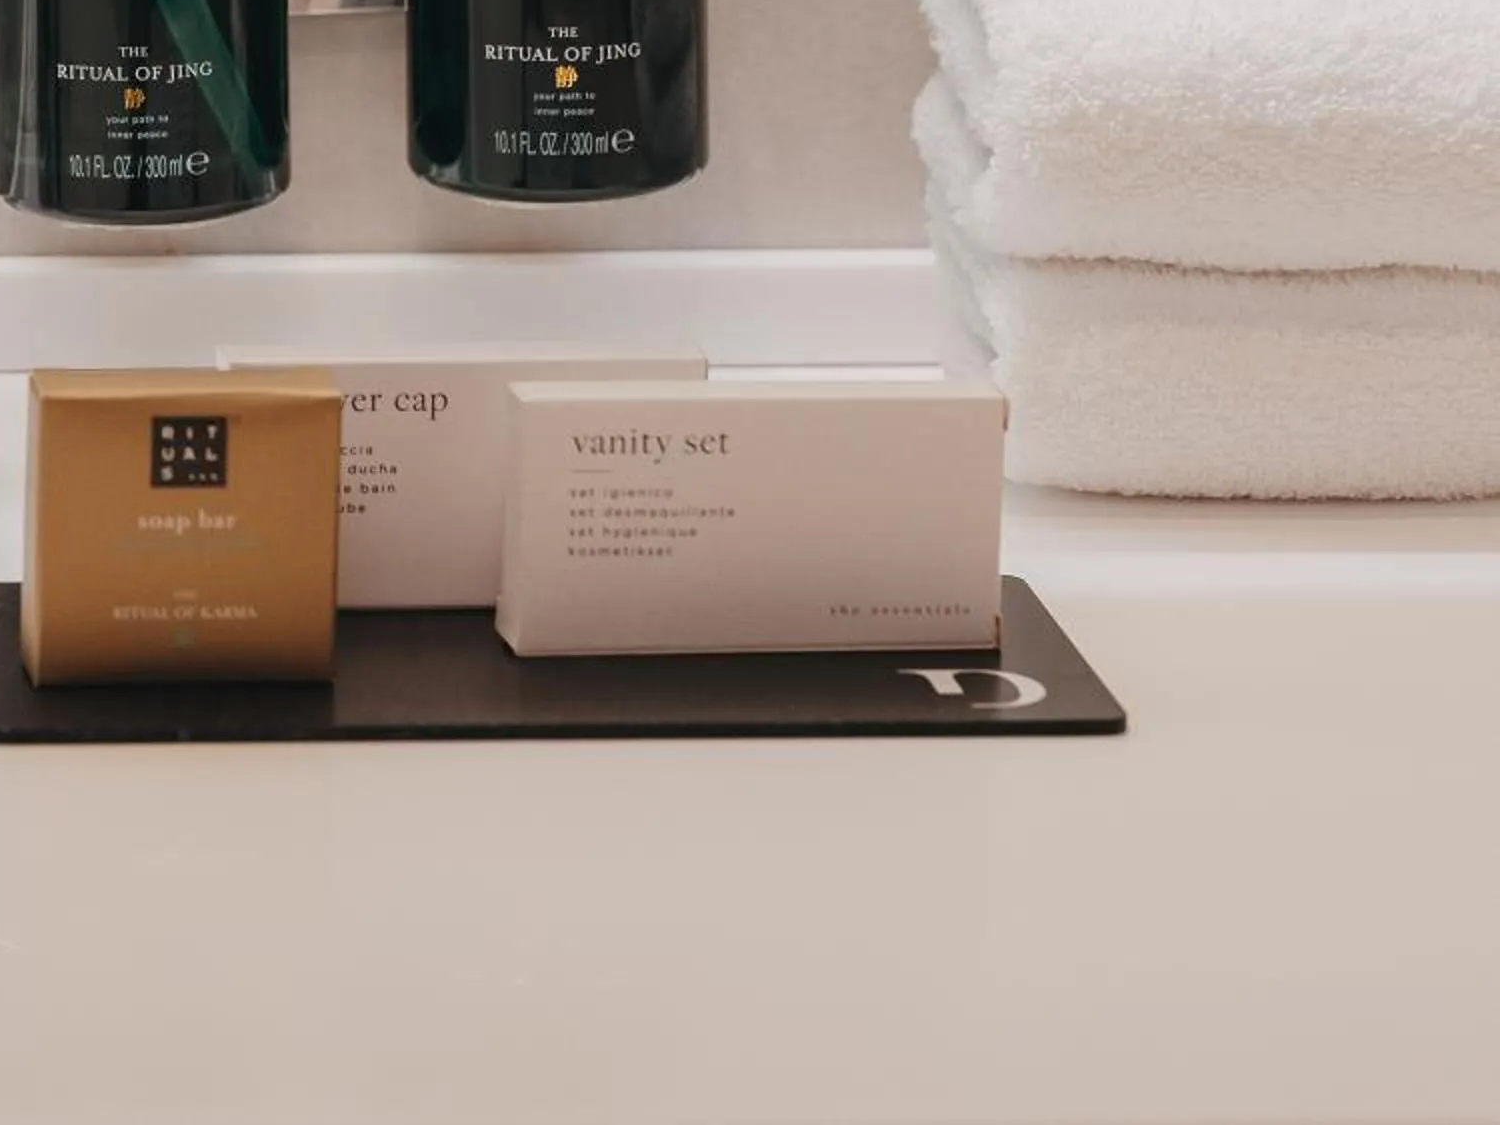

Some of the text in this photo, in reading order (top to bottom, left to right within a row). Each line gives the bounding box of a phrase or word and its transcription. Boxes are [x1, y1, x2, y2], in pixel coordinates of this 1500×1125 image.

[548, 26, 579, 38] THE
[117, 46, 149, 58] THE
[484, 42, 642, 64] RITUAL OF JING
[56, 61, 213, 84] RITUAL OF JING
[571, 131, 593, 156] 300
[595, 131, 609, 154] ml
[145, 155, 167, 179] 300
[169, 154, 183, 177] ml
[394, 392, 449, 421] cap
[572, 428, 730, 465] vanity set
[347, 463, 398, 475] ducha
[359, 482, 396, 494] bain
[137, 507, 238, 535] soap bar
